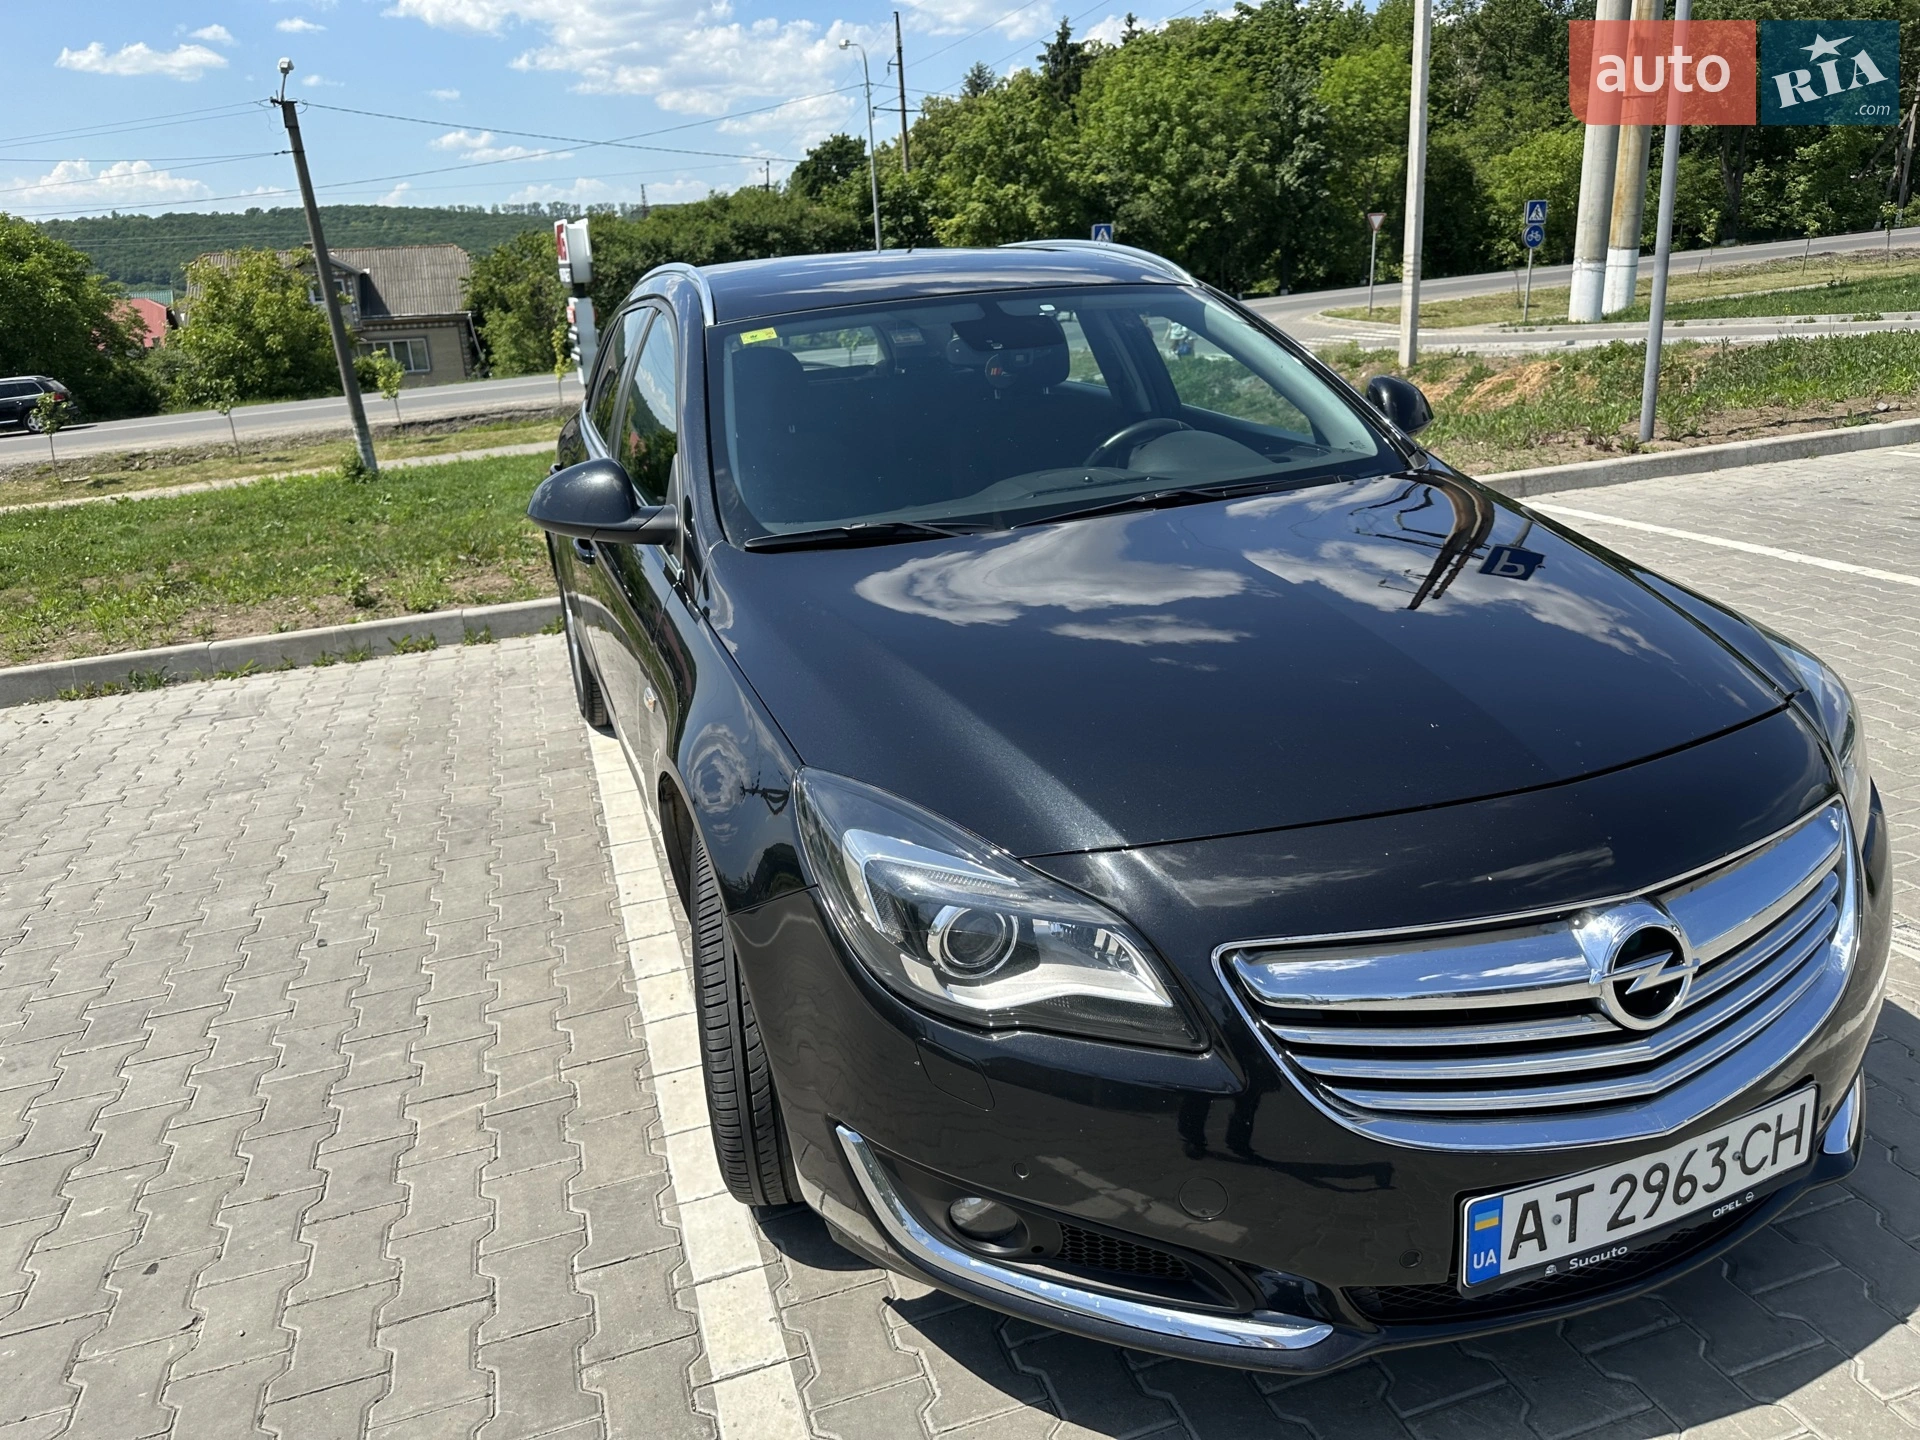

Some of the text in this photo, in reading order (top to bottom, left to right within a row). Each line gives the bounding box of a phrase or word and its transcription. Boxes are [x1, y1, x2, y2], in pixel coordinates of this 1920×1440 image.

[1507, 1103, 1808, 1260] AT 2963 CH
[1712, 1199, 1742, 1218] OPEL
[1473, 1248, 1498, 1269] UA
[1569, 1245, 1628, 1270] Suauto
